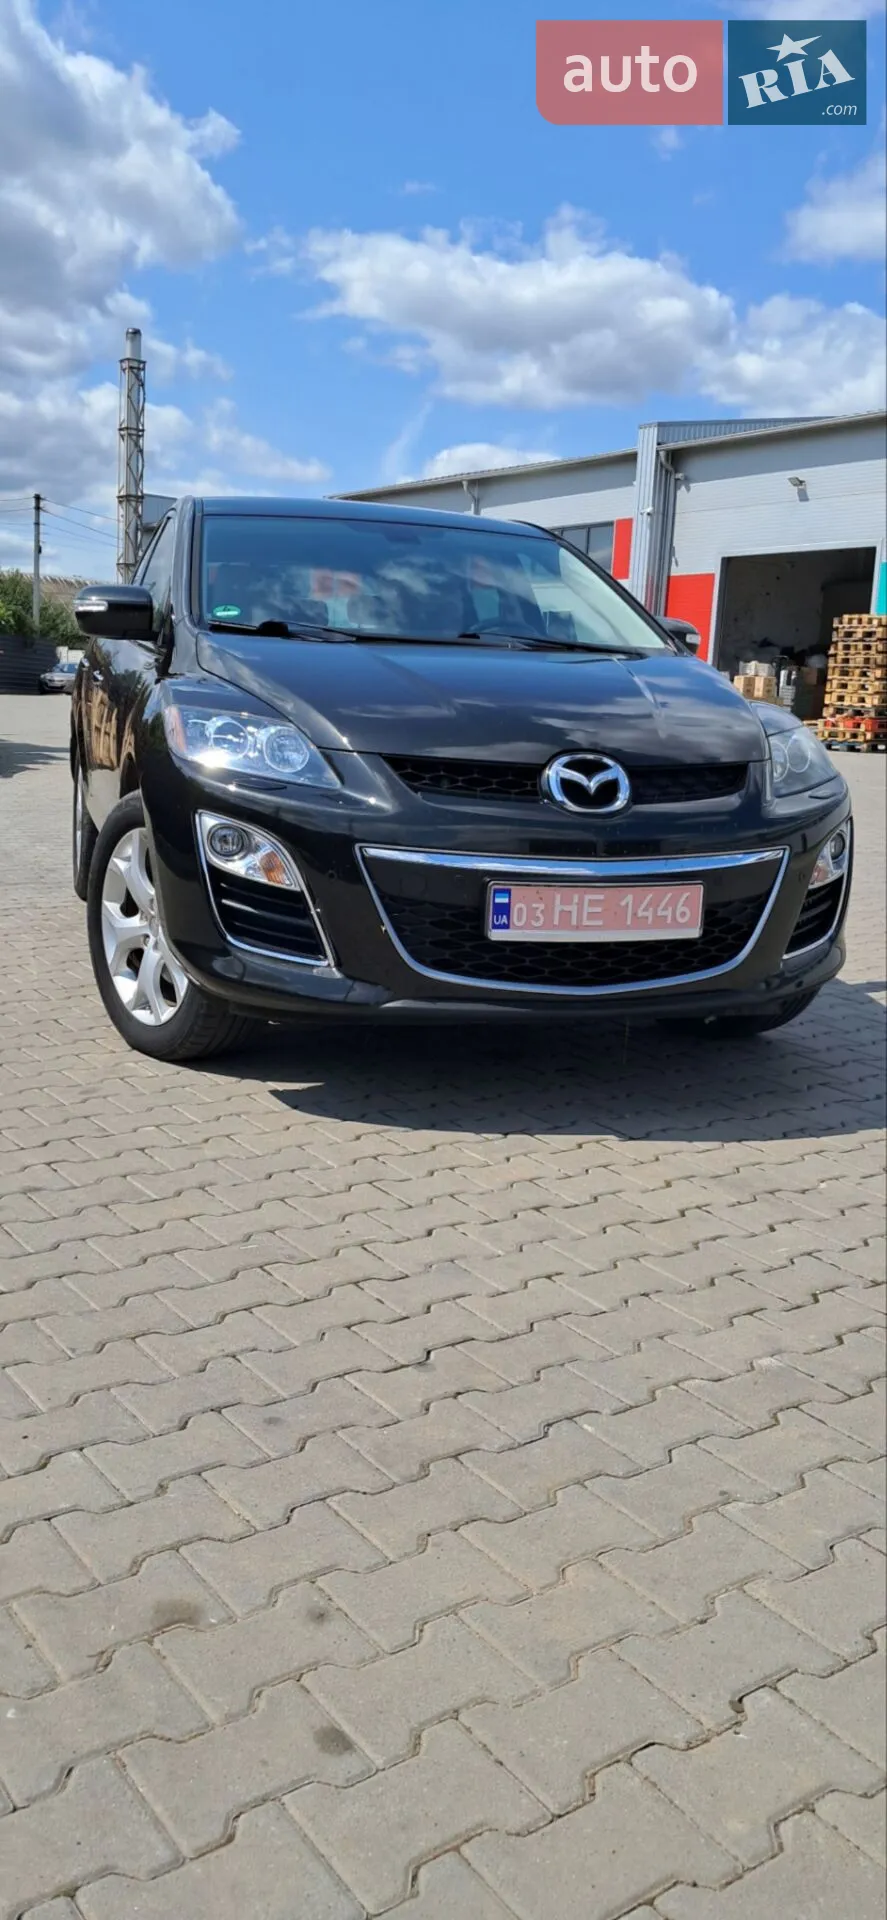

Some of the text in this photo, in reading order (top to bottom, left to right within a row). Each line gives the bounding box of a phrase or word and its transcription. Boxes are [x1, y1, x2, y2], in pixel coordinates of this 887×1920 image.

[493, 914, 509, 926] UA
[512, 892, 692, 927] 03 HE 1446
